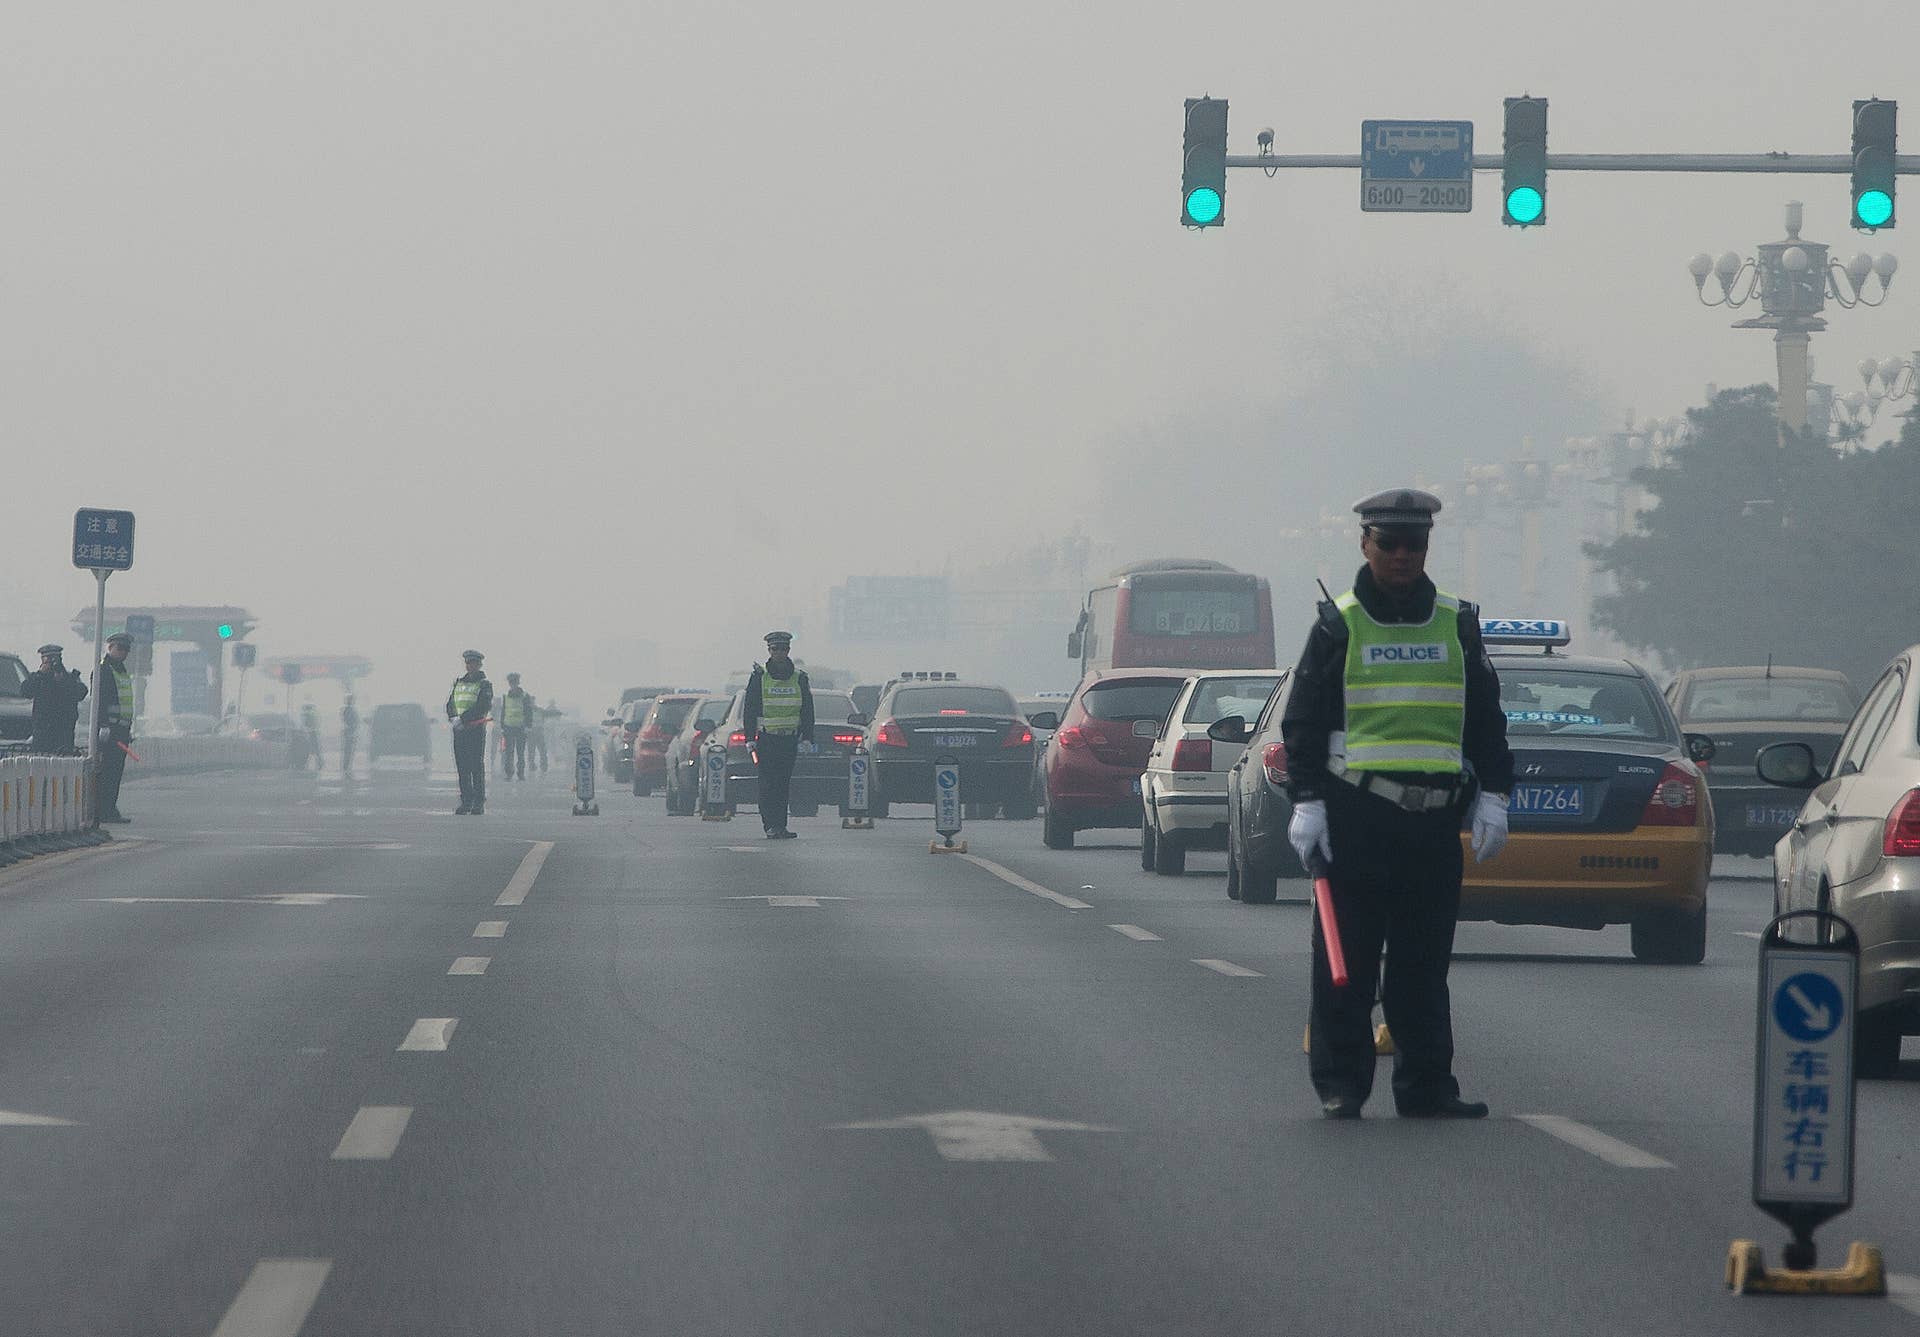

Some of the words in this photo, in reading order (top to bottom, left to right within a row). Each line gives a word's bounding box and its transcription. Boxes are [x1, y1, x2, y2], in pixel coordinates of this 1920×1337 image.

[88, 516, 118, 533] 注意
[77, 544, 128, 561] 交通安全
[1480, 620, 1552, 631] TAXI
[1370, 647, 1441, 661] POLICE
[1517, 788, 1580, 810] N7264
[1783, 1050, 1830, 1182] 车辆右行
